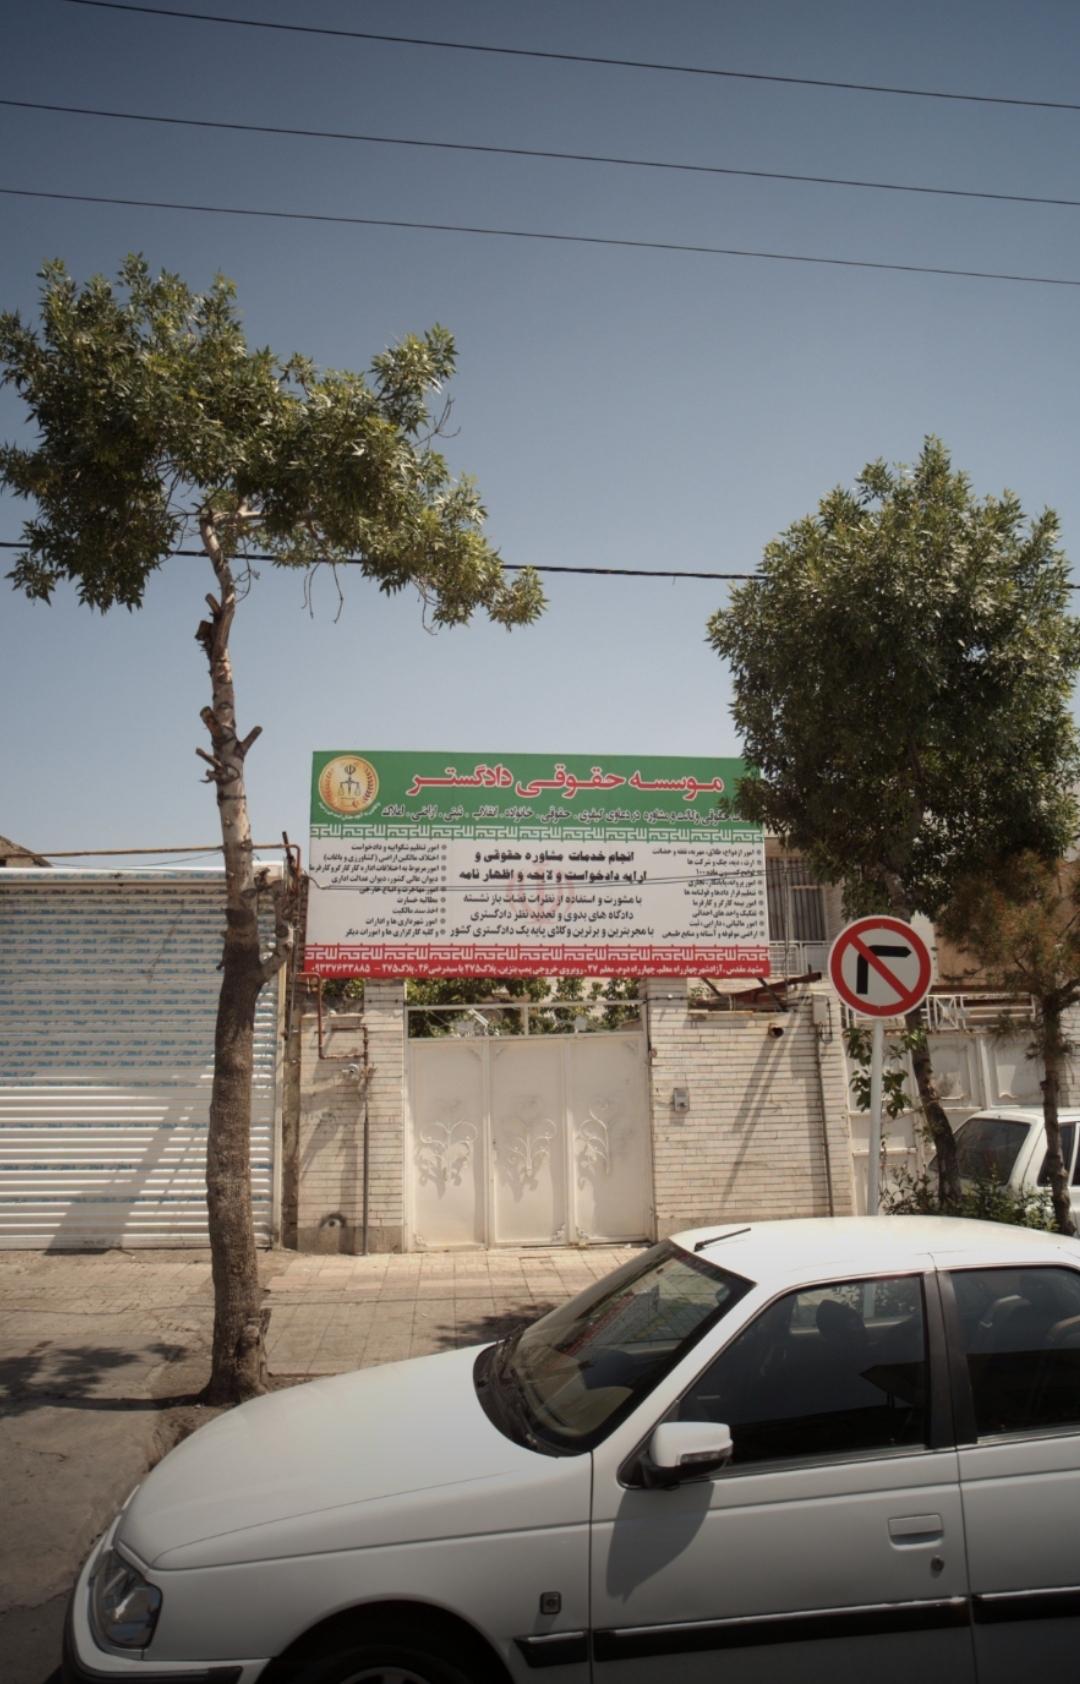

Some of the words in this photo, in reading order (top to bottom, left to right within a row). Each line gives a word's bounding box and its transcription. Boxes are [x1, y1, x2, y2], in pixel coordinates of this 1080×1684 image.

[406, 763, 513, 797] دادگستر
[515, 763, 626, 799] حقوقی
[381, 803, 405, 817] املاک
[411, 804, 439, 822] اراضی
[443, 804, 464, 823] ثبتی
[472, 805, 498, 820] انقلاب
[504, 806, 534, 823] خانواده
[541, 806, 572, 824] حقوقی
[351, 843, 382, 853] دادخواست
[427, 843, 440, 853] امور
[474, 851, 481, 864] و
[484, 849, 522, 864] حقوقی
[525, 850, 564, 864] مشاوره
[568, 850, 606, 862] خدمات
[609, 850, 634, 865] انجام
[459, 868, 480, 880] نامه
[482, 868, 514, 882] اظهار
[517, 871, 524, 883] و
[527, 869, 554, 884] لایحه
[556, 872, 562, 884] و
[565, 869, 620, 884] دادخواست
[463, 893, 490, 903] نشسته
[503, 893, 527, 903] قضات
[527, 893, 556, 906] نظرات
[556, 894, 564, 906] از
[565, 894, 596, 905] استفاده
[597, 896, 603, 907] و
[604, 894, 634, 907] مشورت
[635, 894, 643, 904] با
[390, 916, 397, 925] ها
[470, 908, 513, 922] دادگستری
[514, 908, 530, 922] نظر
[530, 909, 556, 922] تجدید
[556, 911, 563, 923] و
[564, 910, 587, 923] بدوی
[588, 910, 608, 923] های
[608, 910, 634, 921] دادگاه
[449, 924, 472, 938] کشور
[473, 924, 515, 938] دادگستری
[515, 925, 530, 938] یک
[530, 926, 546, 938] پایه
[571, 926, 600, 939] برترین
[602, 927, 607, 939] و
[647, 926, 655, 938] با
